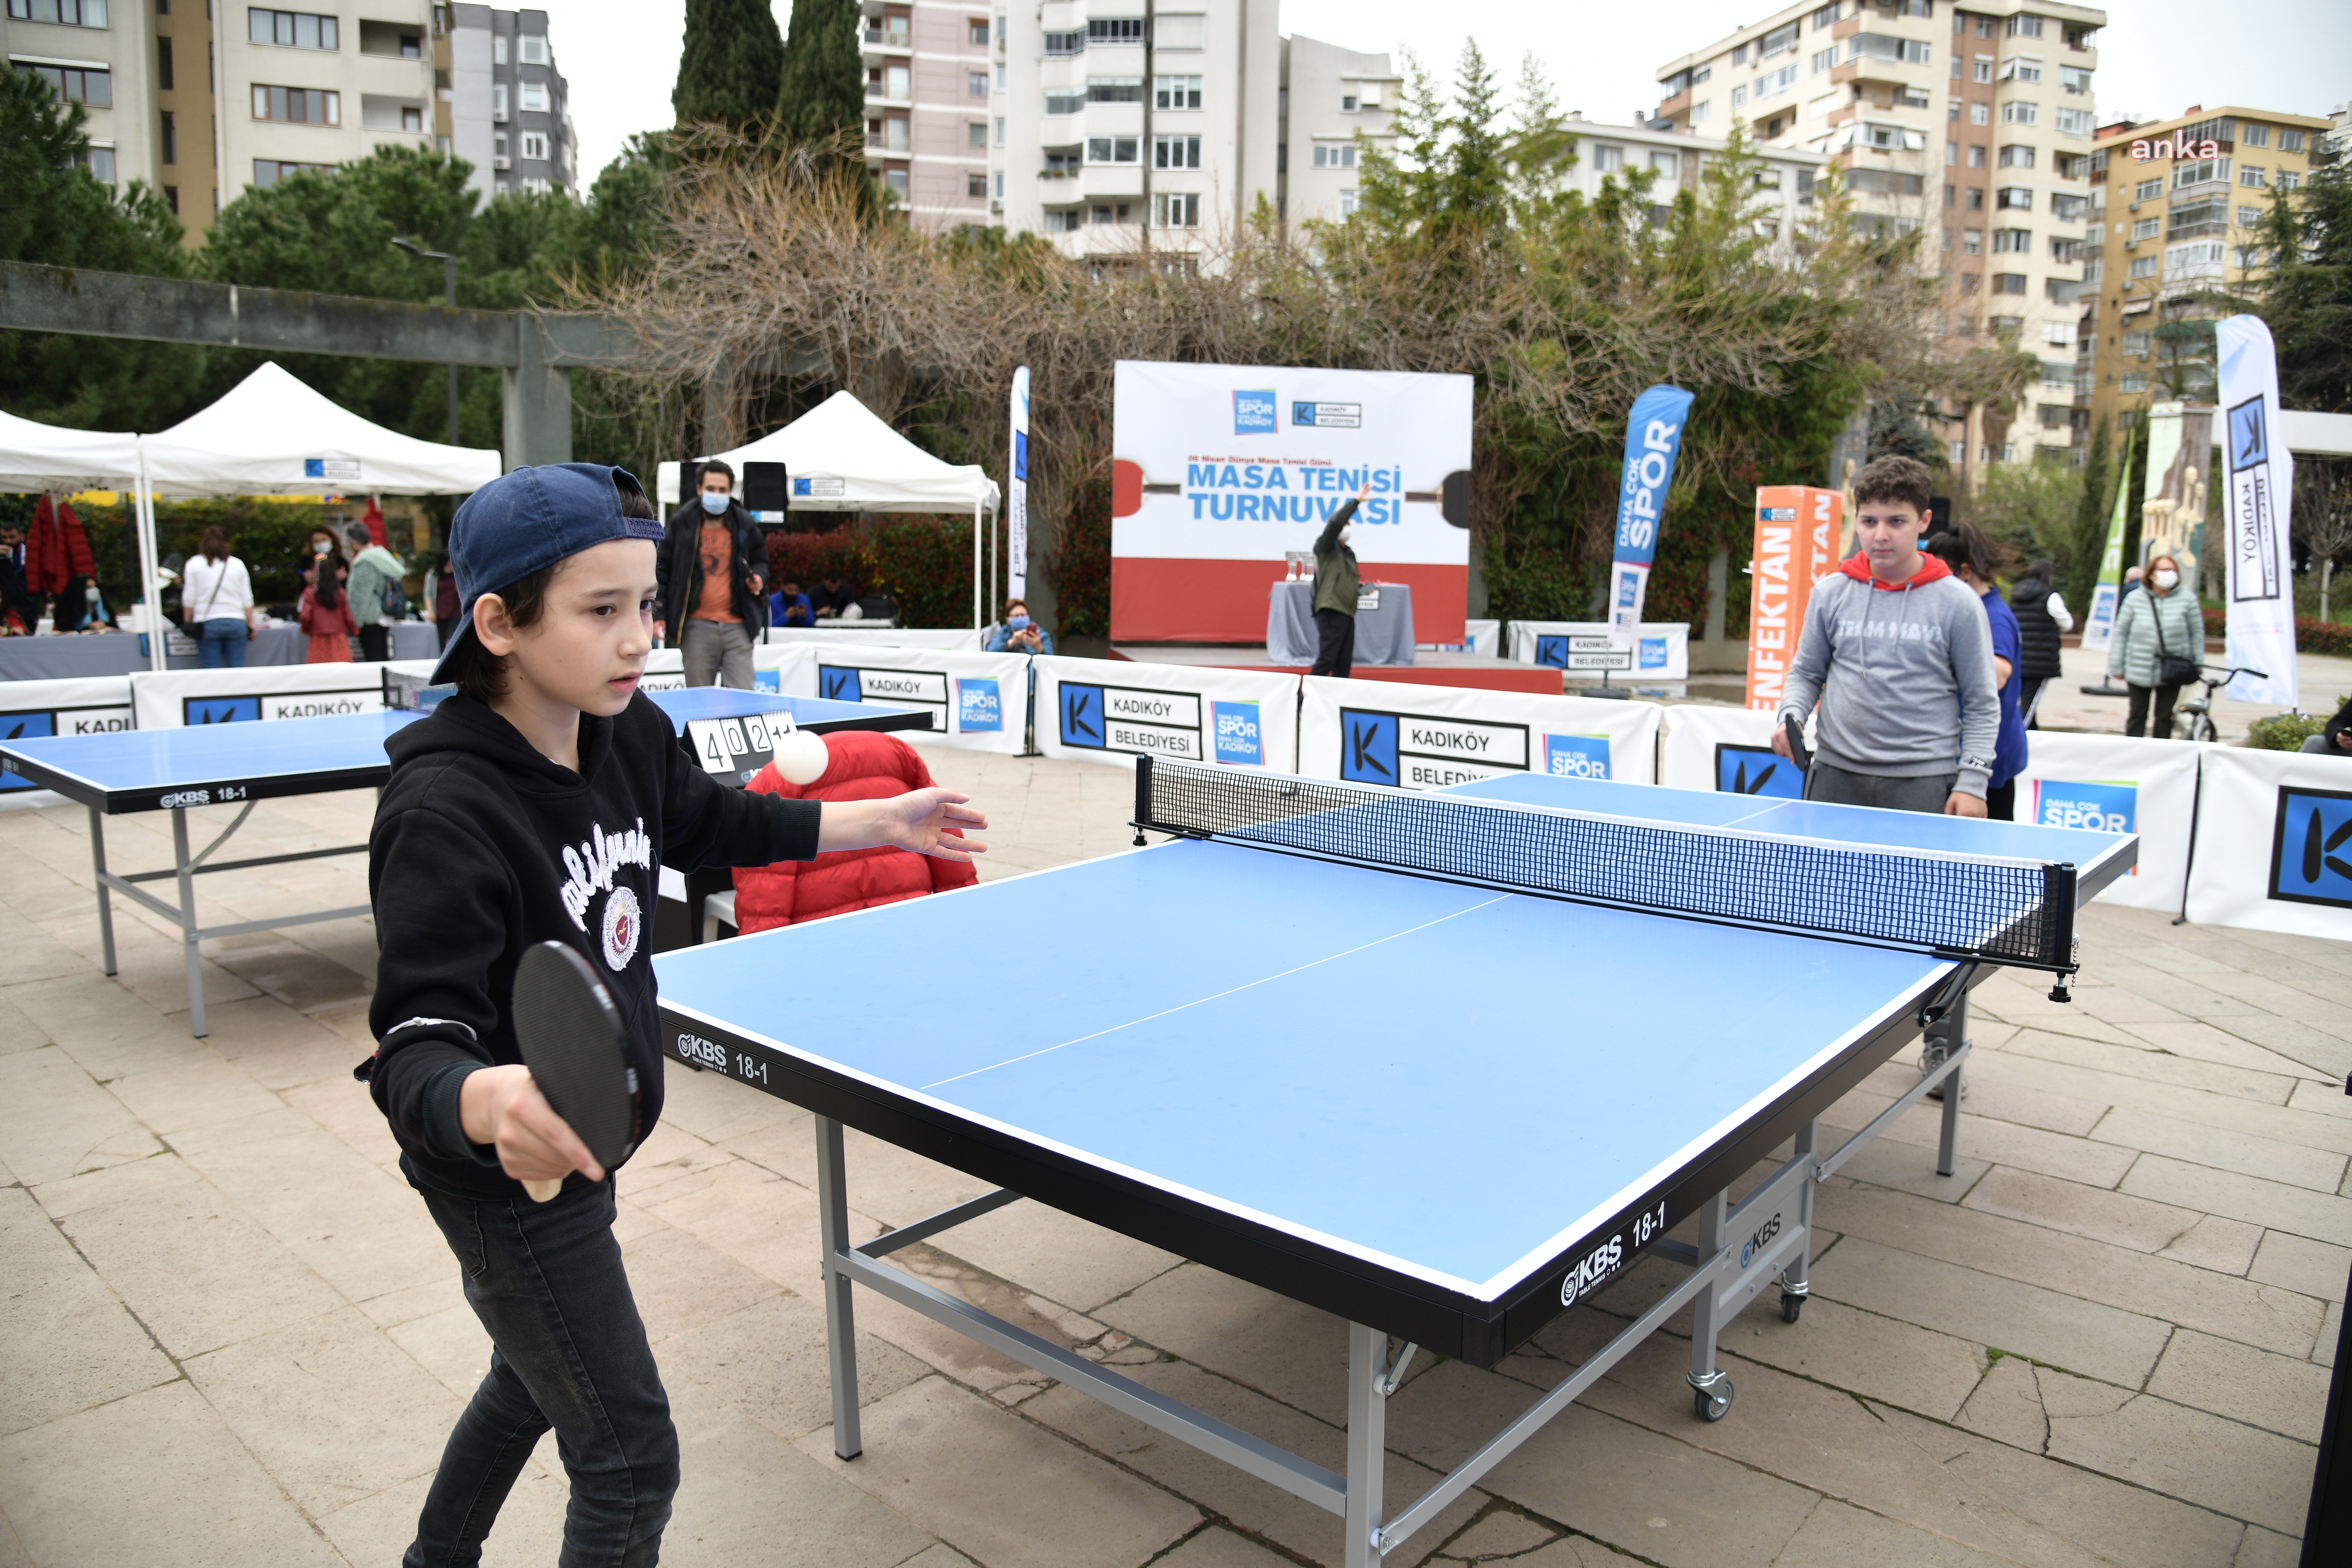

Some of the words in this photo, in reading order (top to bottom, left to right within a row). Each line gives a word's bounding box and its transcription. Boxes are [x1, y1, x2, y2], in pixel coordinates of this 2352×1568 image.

[1238, 402, 1274, 415] SPOR
[1188, 464, 1288, 489] MASA
[1300, 463, 1401, 493] TENİSİ
[1629, 419, 1677, 550] SPOR
[1619, 499, 1634, 547] DAHA
[1838, 620, 1885, 638] TEAM
[868, 677, 921, 693] KADIKÖY
[277, 699, 364, 719] KADIKÖY
[962, 695, 998, 709] SPOR
[1114, 699, 1171, 716] KADIKÖY
[75, 718, 129, 734] KADI
[1218, 720, 1257, 738] SPOR
[707, 733, 724, 767] 4
[752, 725, 769, 749] 2
[1116, 730, 1189, 752] BELEDİYESİ
[1412, 729, 1489, 752] KADIKÖY
[1551, 757, 1606, 779] SPOR
[174, 789, 210, 805] KBS
[217, 785, 247, 801] 18-1
[2045, 798, 2075, 809] DAHA
[2043, 807, 2127, 833] SPOR
[691, 1034, 727, 1067] KBS
[736, 1053, 767, 1084] 18-1
[692, 1056, 702, 1064] TABLE
[702, 1059, 714, 1069] TENNIS
[1579, 1234, 1622, 1288] KBS
[1633, 1201, 1664, 1247] 18-1
[1752, 1212, 1781, 1255] KBS
[1578, 1284, 1591, 1297] TABLE
[1591, 1273, 1606, 1289] TENNIS
